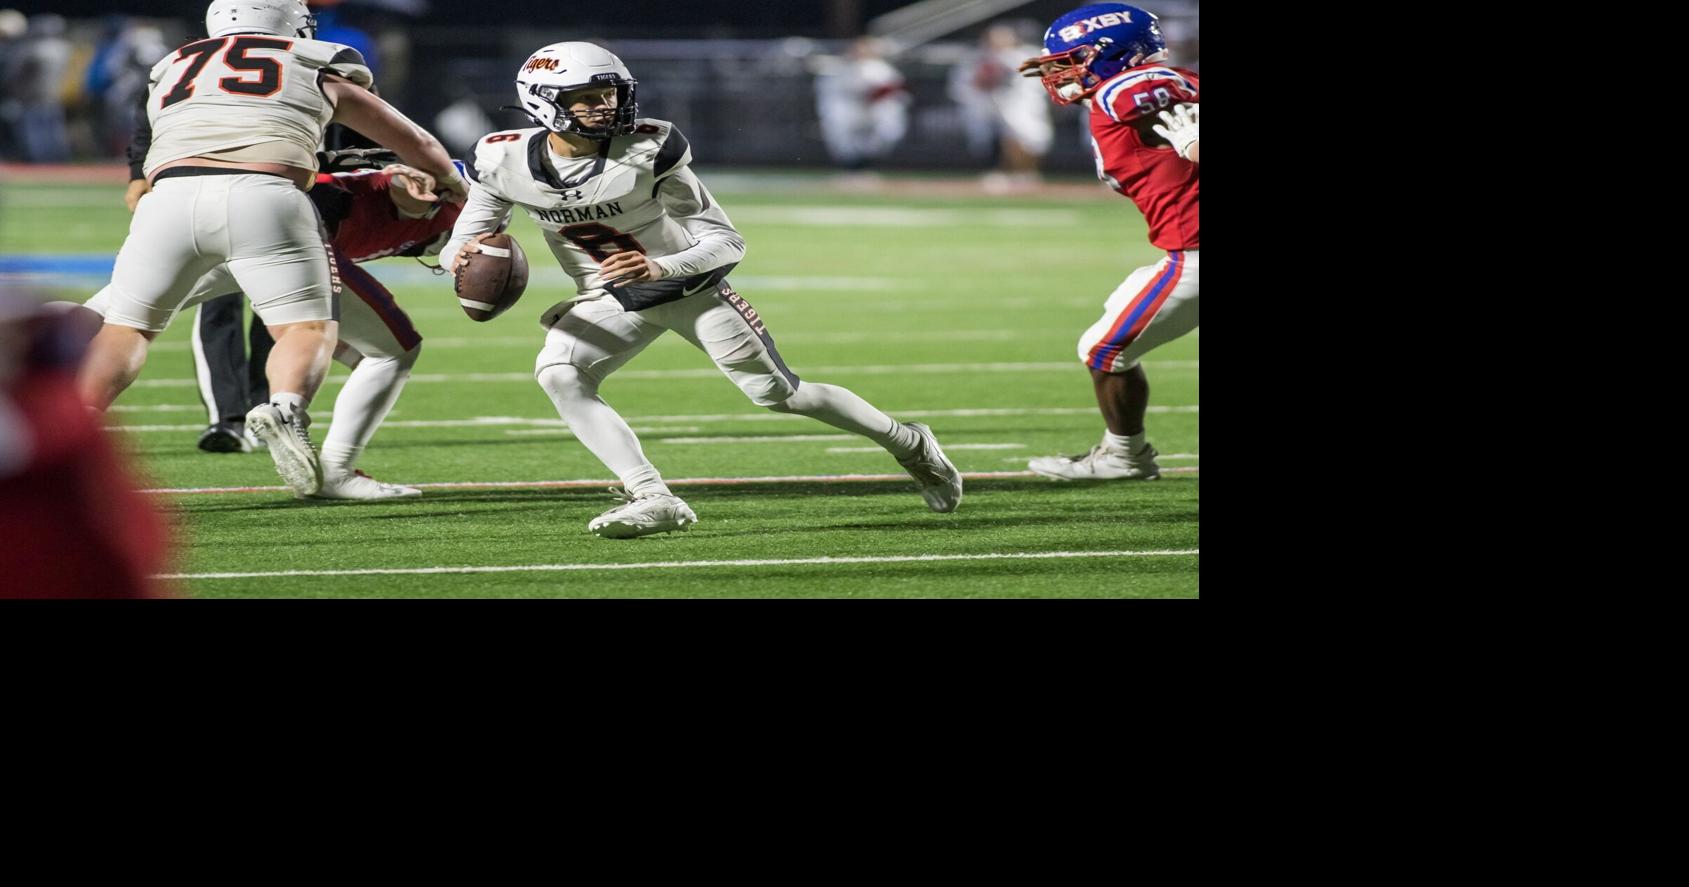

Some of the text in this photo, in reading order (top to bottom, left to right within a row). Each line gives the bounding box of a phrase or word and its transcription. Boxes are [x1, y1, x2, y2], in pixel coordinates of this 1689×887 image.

[161, 36, 293, 110] 75
[1133, 87, 1171, 115] 58
[486, 133, 522, 144] 6
[536, 201, 623, 224] NORMAN
[721, 288, 766, 335] TIGERS
